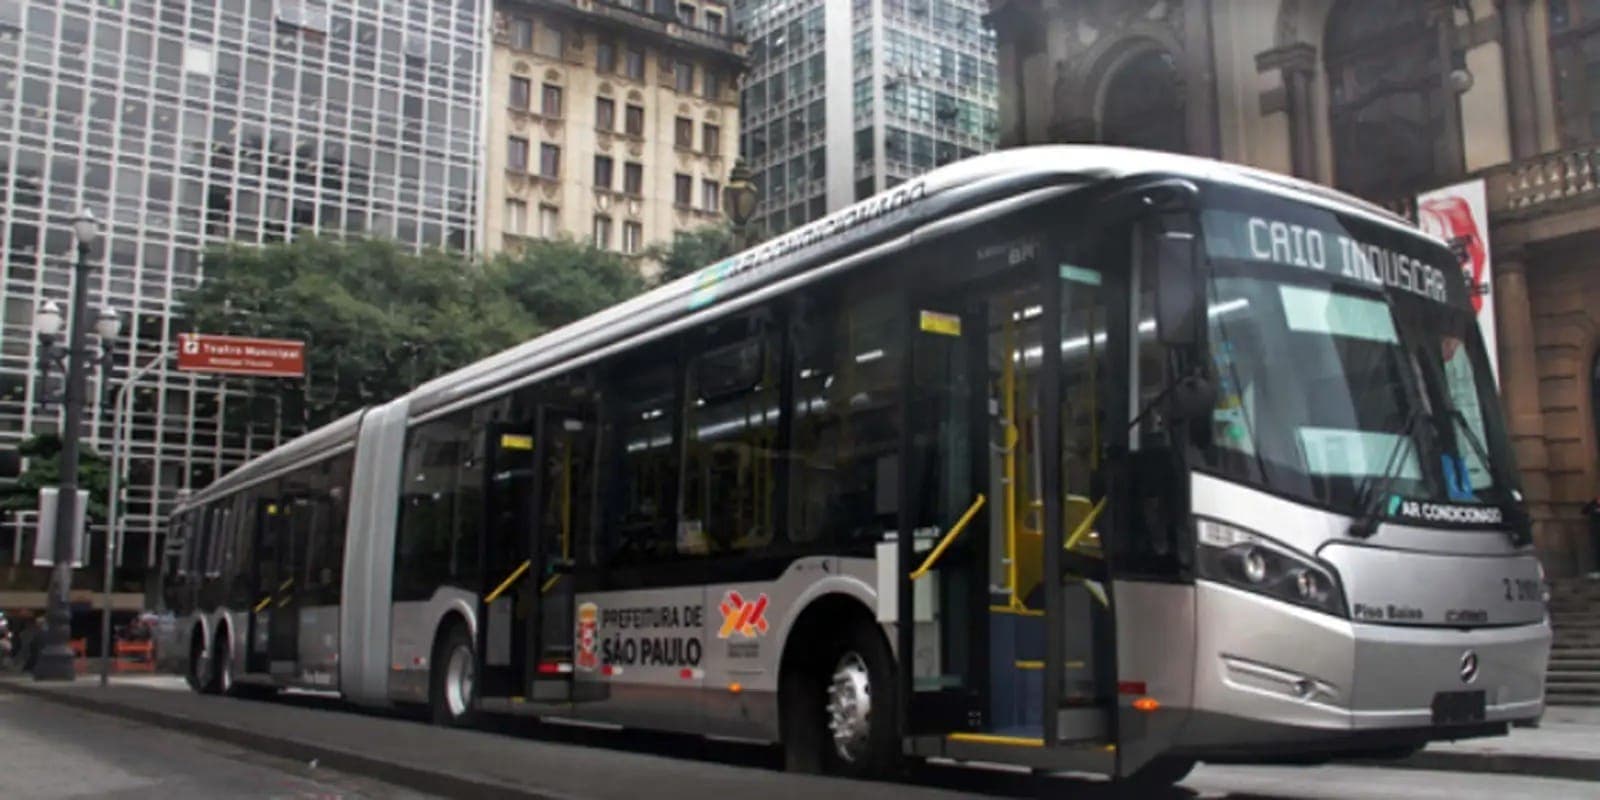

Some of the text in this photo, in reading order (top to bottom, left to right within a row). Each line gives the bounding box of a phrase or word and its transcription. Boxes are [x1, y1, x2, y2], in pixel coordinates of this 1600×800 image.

[1248, 217, 1326, 270] CAIO
[1338, 236, 1447, 303] INDUSCAR
[203, 343, 299, 359] Teatro Municipal
[1402, 501, 1420, 517] AR
[603, 606, 704, 629] PREFEITURA DE
[602, 632, 635, 666] SÃO
[641, 637, 702, 665] PAULO
